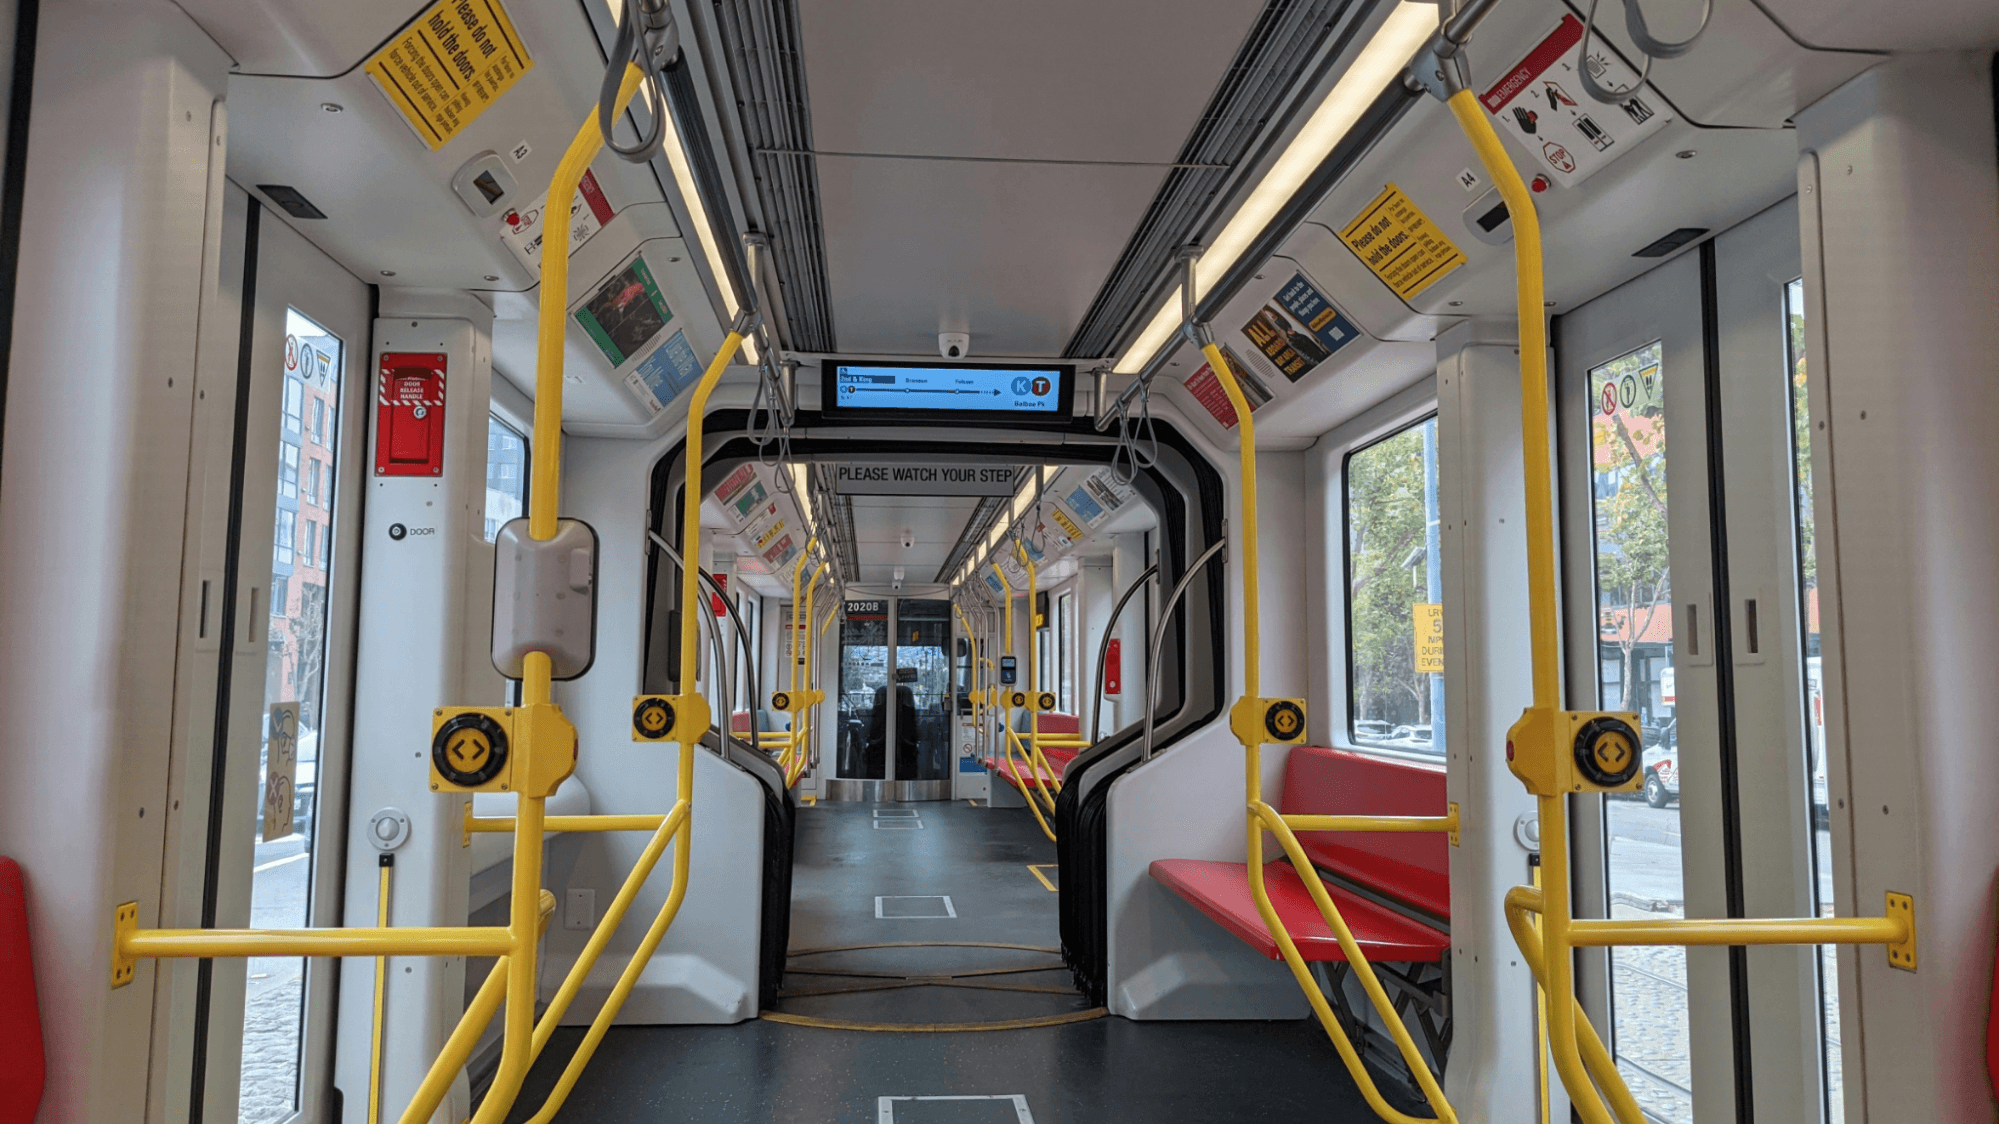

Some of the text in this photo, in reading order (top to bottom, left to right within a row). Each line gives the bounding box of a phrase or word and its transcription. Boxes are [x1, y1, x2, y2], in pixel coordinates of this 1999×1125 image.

[452, 0, 479, 30] lease
[472, 25, 488, 43] do
[428, 10, 475, 82] hold the doors.
[479, 38, 497, 59] not
[389, 48, 403, 66] force
[399, 63, 416, 83] vehicle
[411, 80, 423, 91] out
[402, 36, 450, 101] Forcing the doors open can
[1496, 67, 1531, 100] EMERGENCY
[512, 144, 528, 160] A3
[1549, 149, 1565, 164] STOP
[1460, 172, 1476, 188] A4
[1351, 232, 1375, 251] Please
[1370, 225, 1382, 236] do
[1378, 216, 1392, 230] not
[1366, 249, 1384, 266] hold
[1378, 244, 1392, 256] the
[1387, 231, 1409, 249] doors.
[1248, 320, 1276, 347] ALL
[1284, 357, 1305, 375] TRANSIT
[1016, 380, 1026, 392] K
[1036, 380, 1046, 392] T
[838, 467, 1012, 482] PLEASE WATCH YOUR STEP
[410, 528, 435, 536] DOOR
[848, 602, 879, 611] 2020B
[1433, 619, 1442, 633] 5
